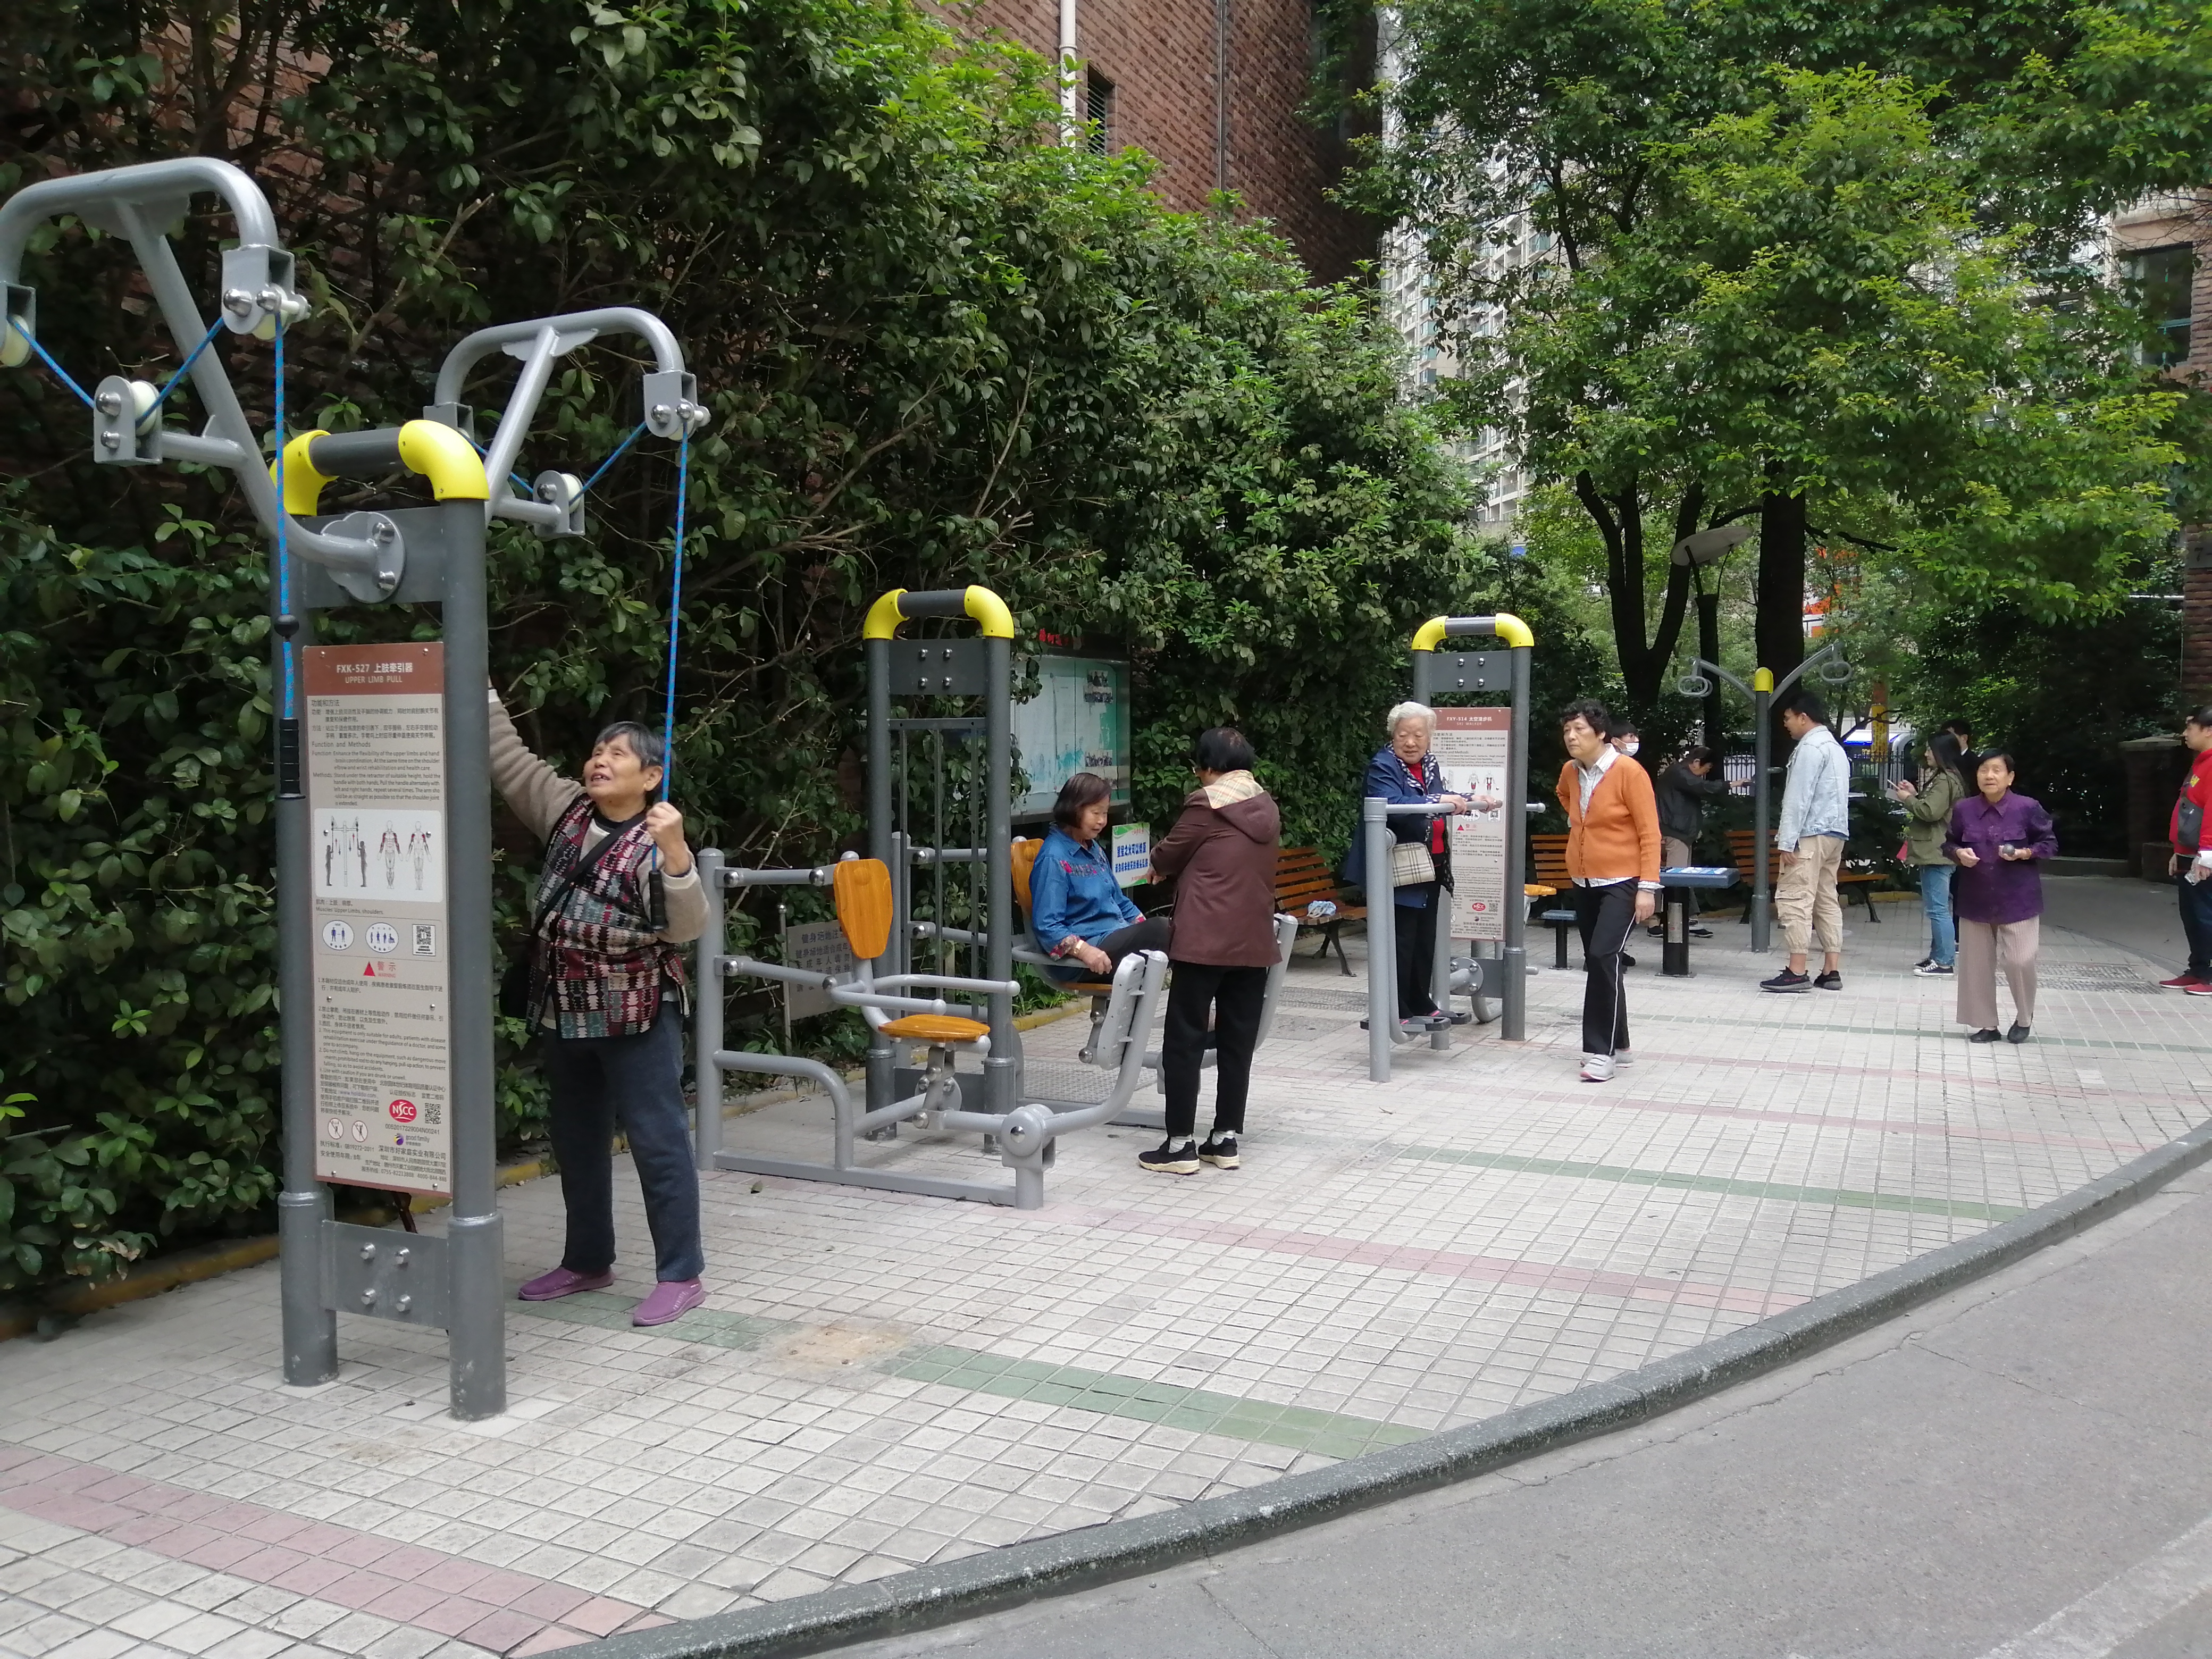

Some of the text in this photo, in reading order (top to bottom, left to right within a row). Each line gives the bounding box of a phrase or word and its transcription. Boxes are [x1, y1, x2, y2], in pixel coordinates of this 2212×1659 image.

[337, 662, 413, 673] FXK-527 上肢牵引器
[378, 961, 396, 971] 警示
[392, 1101, 414, 1117] NSCC
